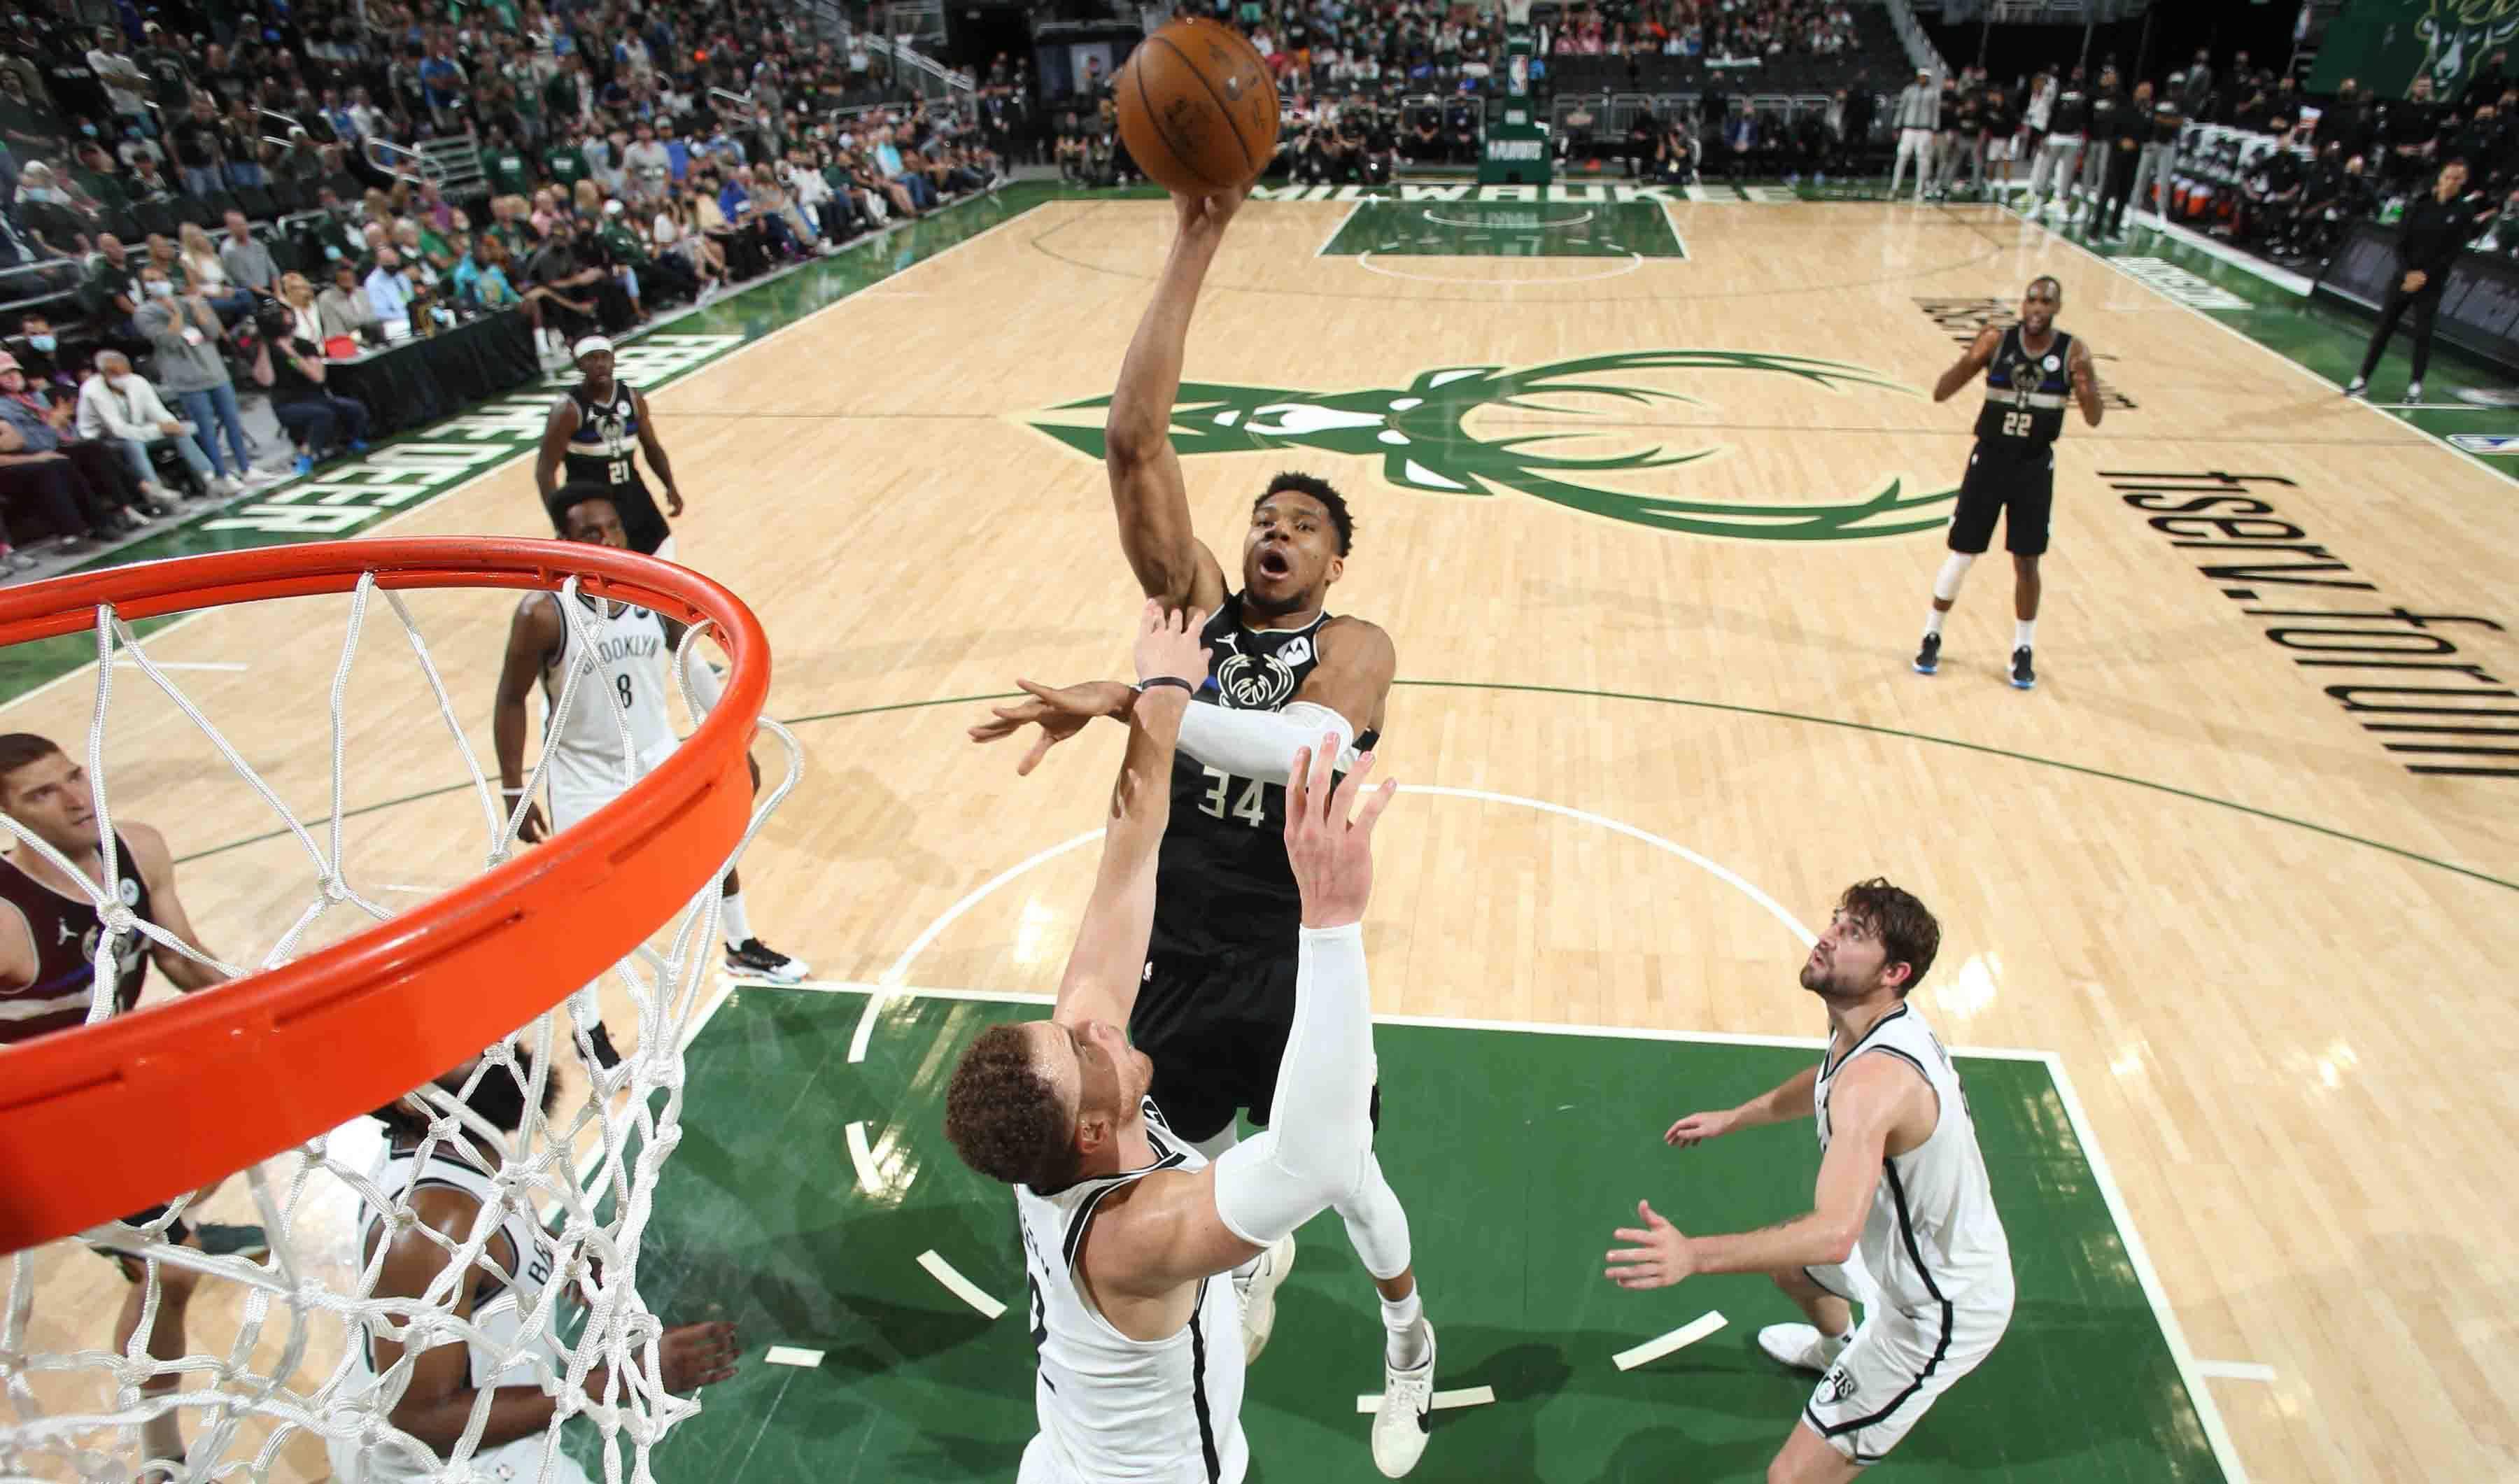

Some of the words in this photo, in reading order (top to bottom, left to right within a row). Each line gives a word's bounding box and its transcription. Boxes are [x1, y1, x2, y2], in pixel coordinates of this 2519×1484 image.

[1248, 184, 1800, 202] MILWAUKEE
[2002, 411, 2033, 437] 22
[201, 443, 514, 532] DEER
[607, 460, 630, 484] 21
[582, 635, 658, 676] OOKLYN
[617, 673, 632, 709] 8
[1198, 765, 1265, 827] 34
